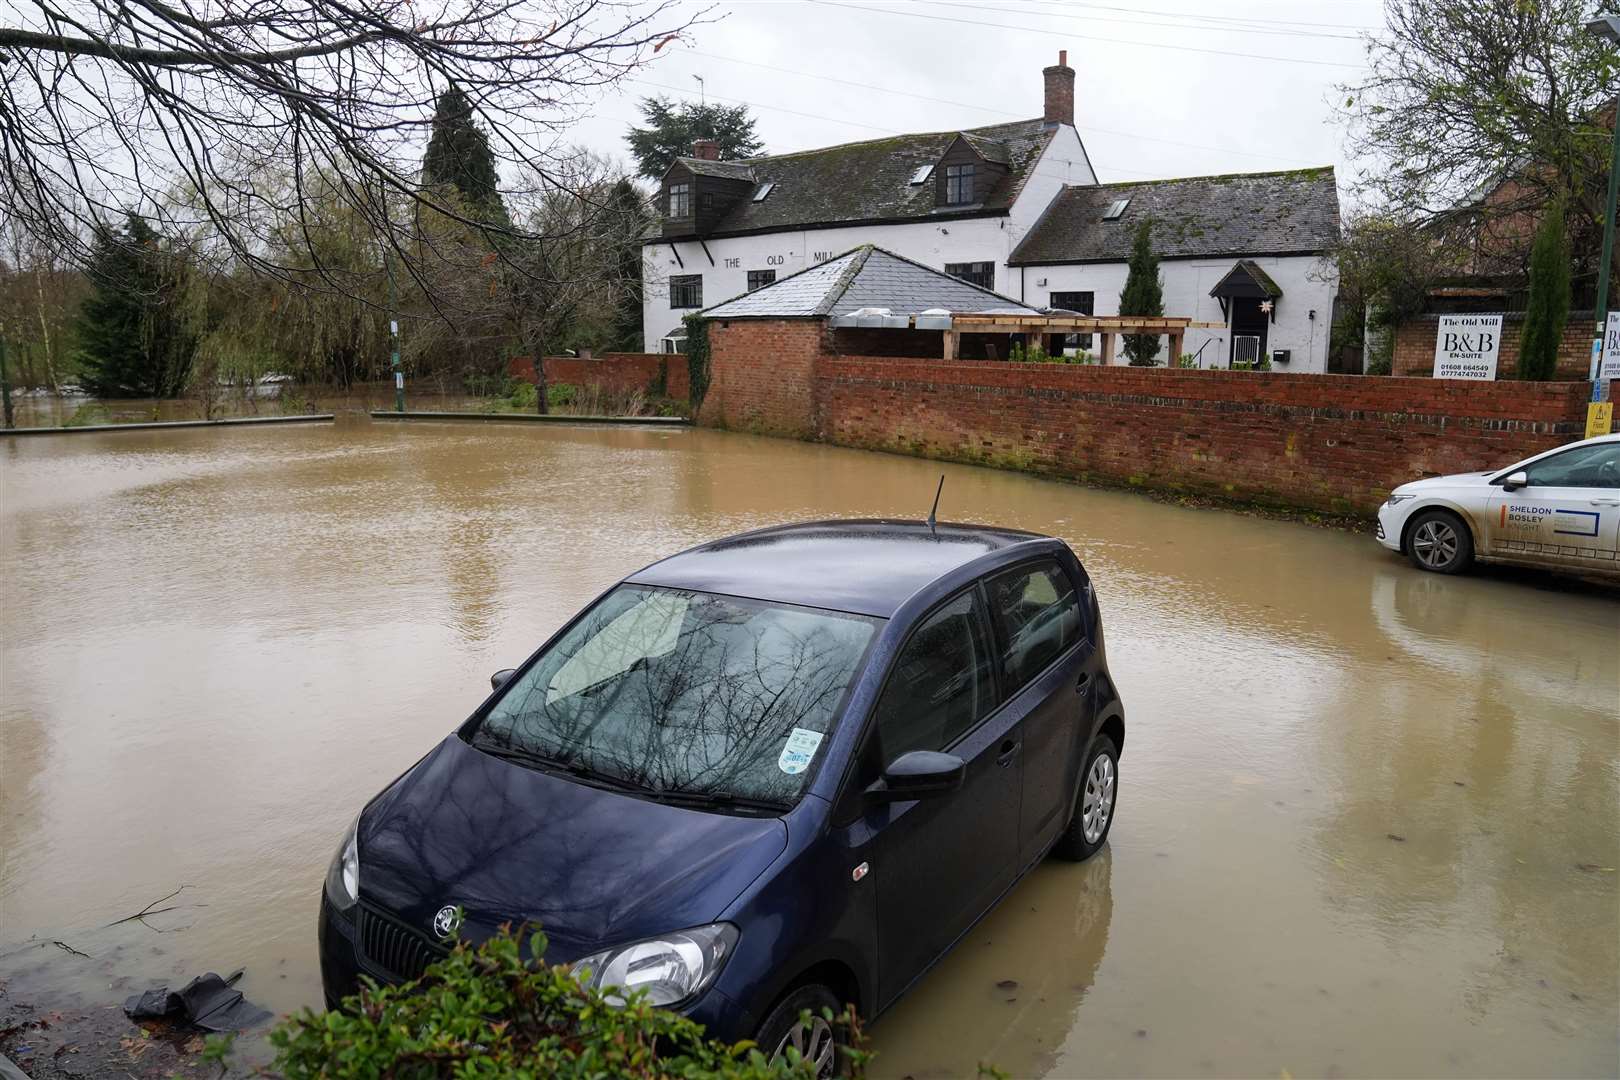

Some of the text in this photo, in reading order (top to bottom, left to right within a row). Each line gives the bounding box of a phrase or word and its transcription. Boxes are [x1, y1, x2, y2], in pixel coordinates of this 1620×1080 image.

[724, 258, 740, 269] THE
[766, 255, 785, 266] OLD
[1442, 318, 1498, 326] The Old Mill
[1443, 332, 1493, 353] B&B
[1509, 505, 1552, 515] SHELDON
[1508, 513, 1543, 523] BOSLEY
